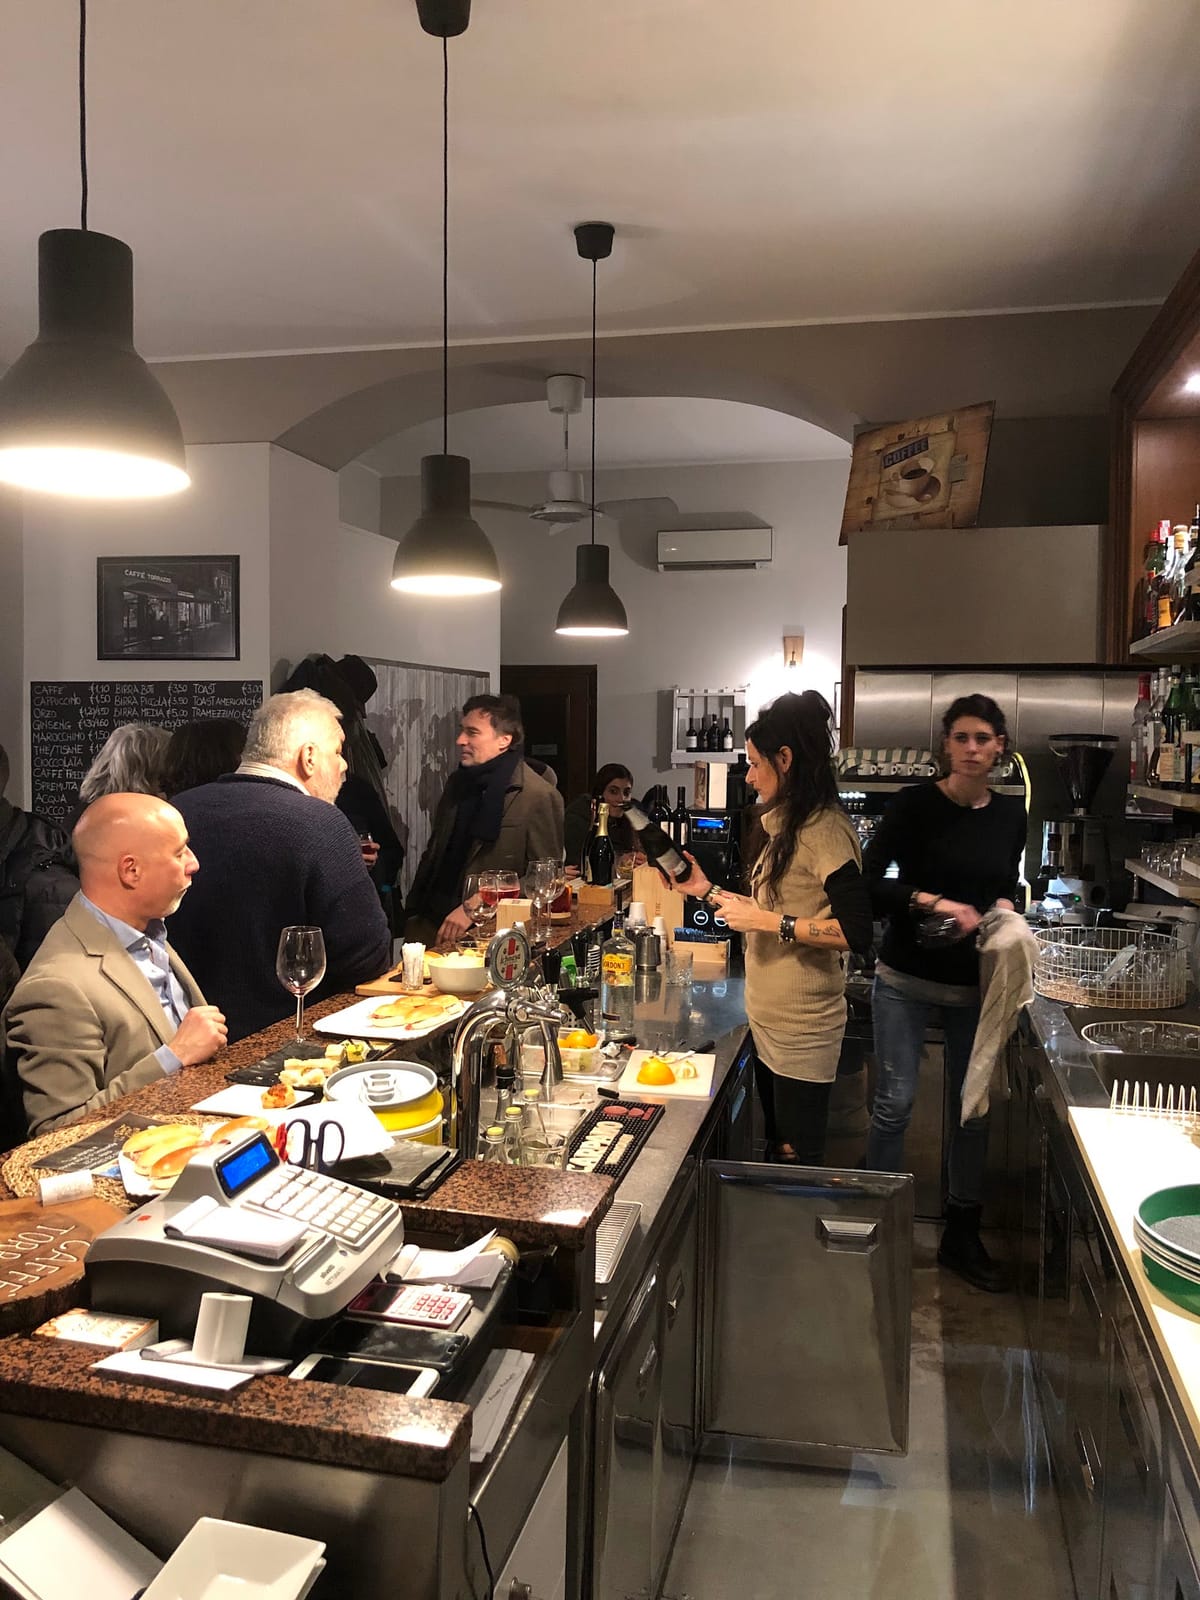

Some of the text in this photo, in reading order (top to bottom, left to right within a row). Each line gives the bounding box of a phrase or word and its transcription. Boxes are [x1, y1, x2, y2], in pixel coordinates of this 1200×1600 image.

[192, 683, 216, 694] TOAST
[114, 695, 139, 706] BIRRA
[192, 695, 215, 706] TOAST
[113, 707, 139, 717] BIRRA
[141, 708, 165, 718] MEDIA
[192, 707, 240, 718] TRAMEZZINO
[32, 719, 71, 730] GINSENG
[33, 731, 85, 743] MAROCCHINO
[33, 756, 83, 768] CIOCCOLATA
[34, 779, 79, 791] SPREMUTA
[35, 793, 67, 804] ACQUA
[35, 805, 64, 816] SUCCO
